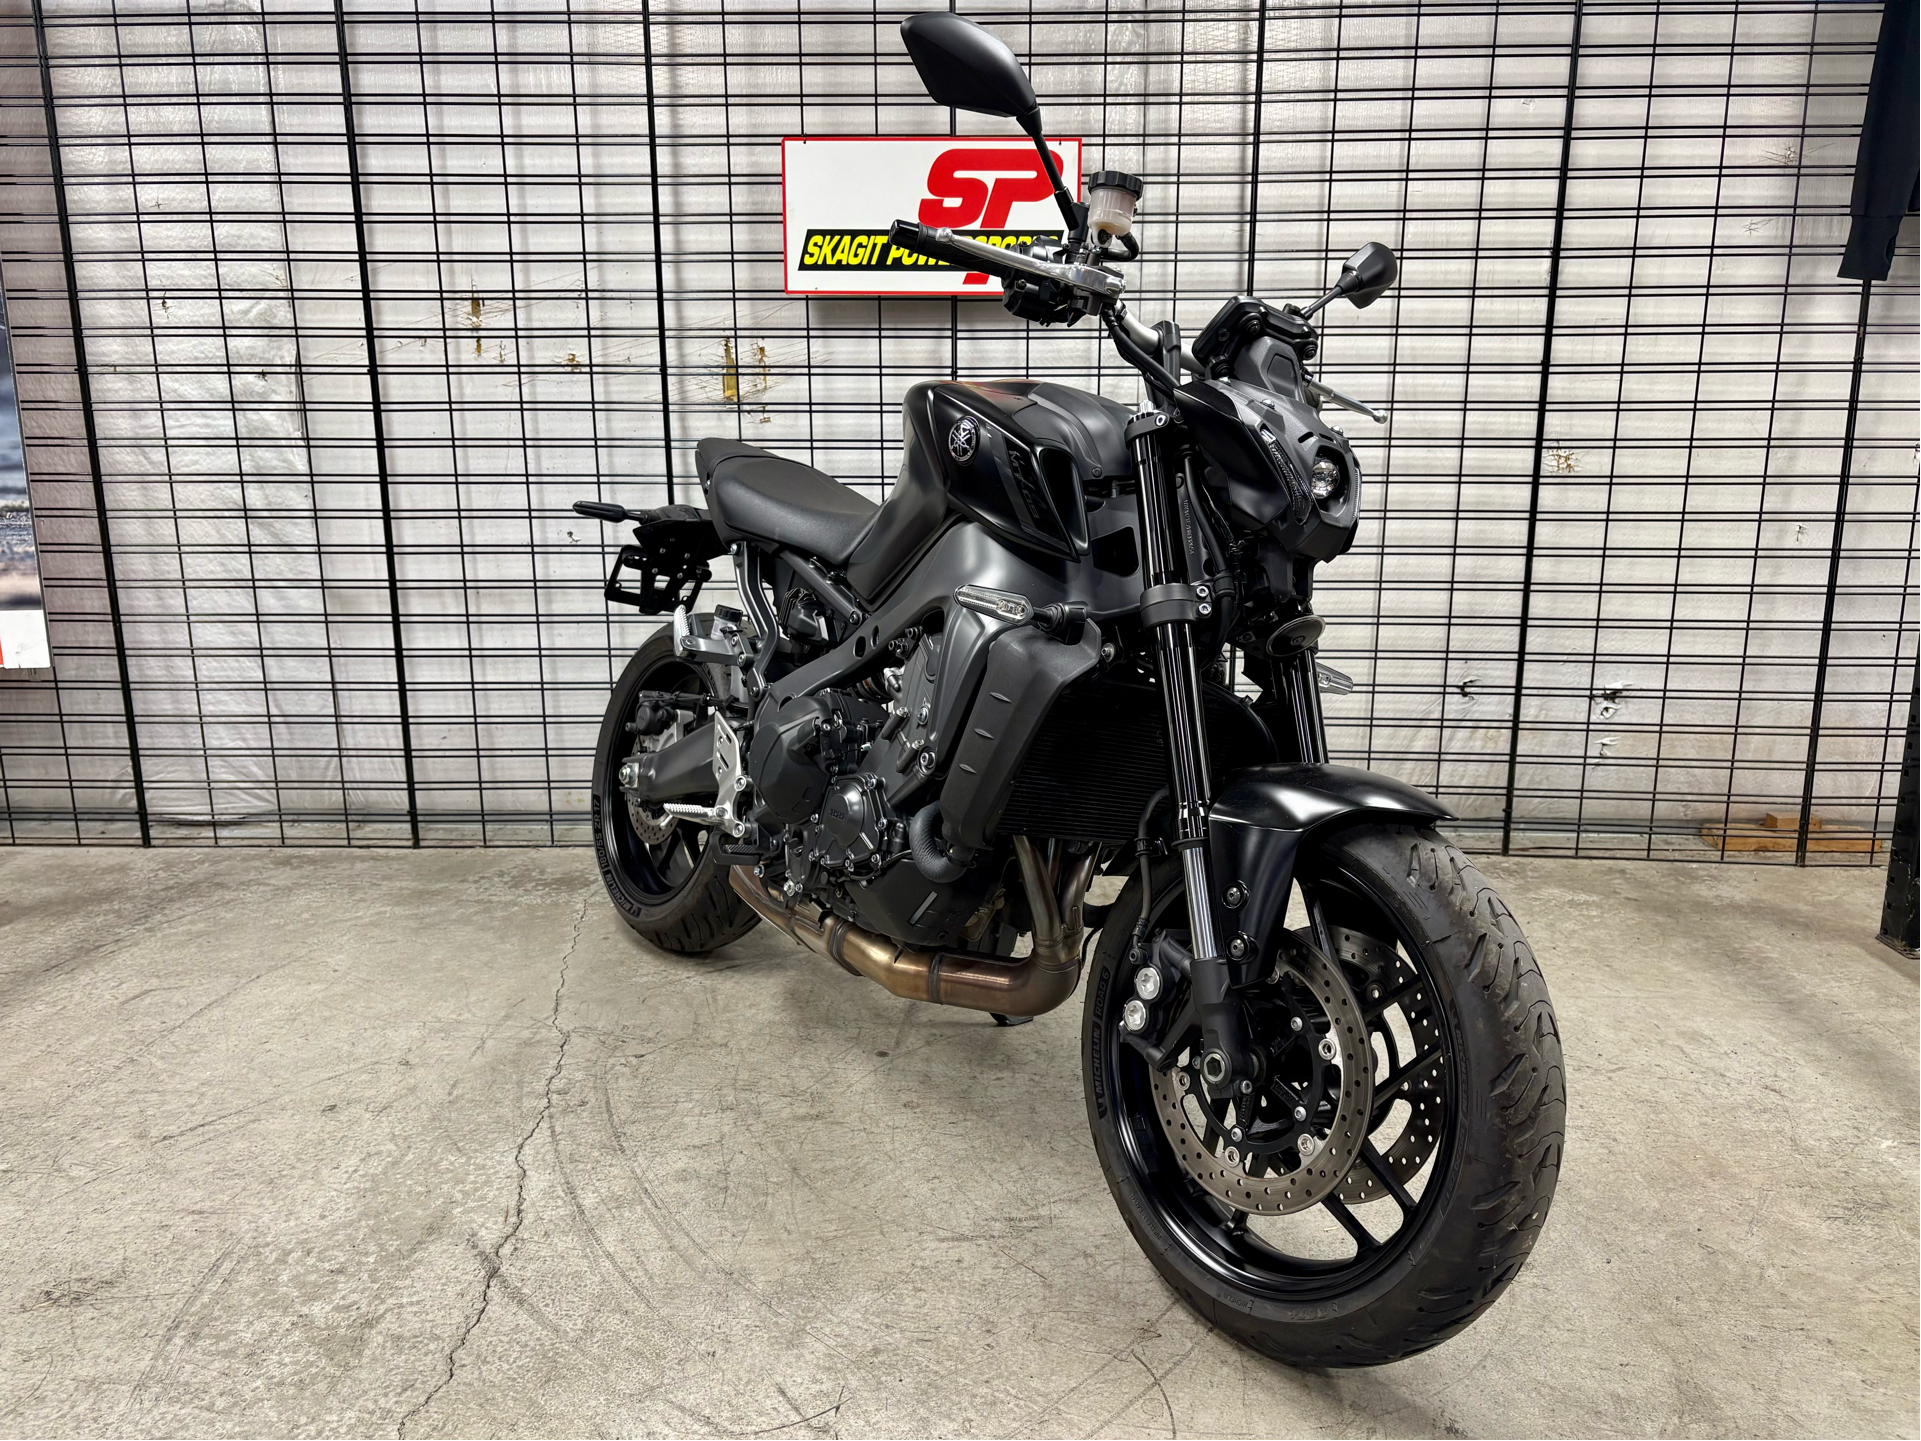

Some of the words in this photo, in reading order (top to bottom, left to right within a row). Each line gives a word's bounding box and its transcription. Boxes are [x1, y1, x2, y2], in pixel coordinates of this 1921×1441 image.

[918, 149, 1064, 284] SP
[804, 235, 888, 265] SKAGIT
[594, 800, 602, 812] 17
[594, 813, 602, 829] ZR
[596, 832, 610, 868] 180/55
[605, 871, 635, 914] MICHELIN
[1102, 970, 1110, 980] 6
[1095, 981, 1107, 1016] ROAD
[1093, 1027, 1104, 1097] MICHELIN
[1455, 1029, 1468, 1113] MICHELIN
